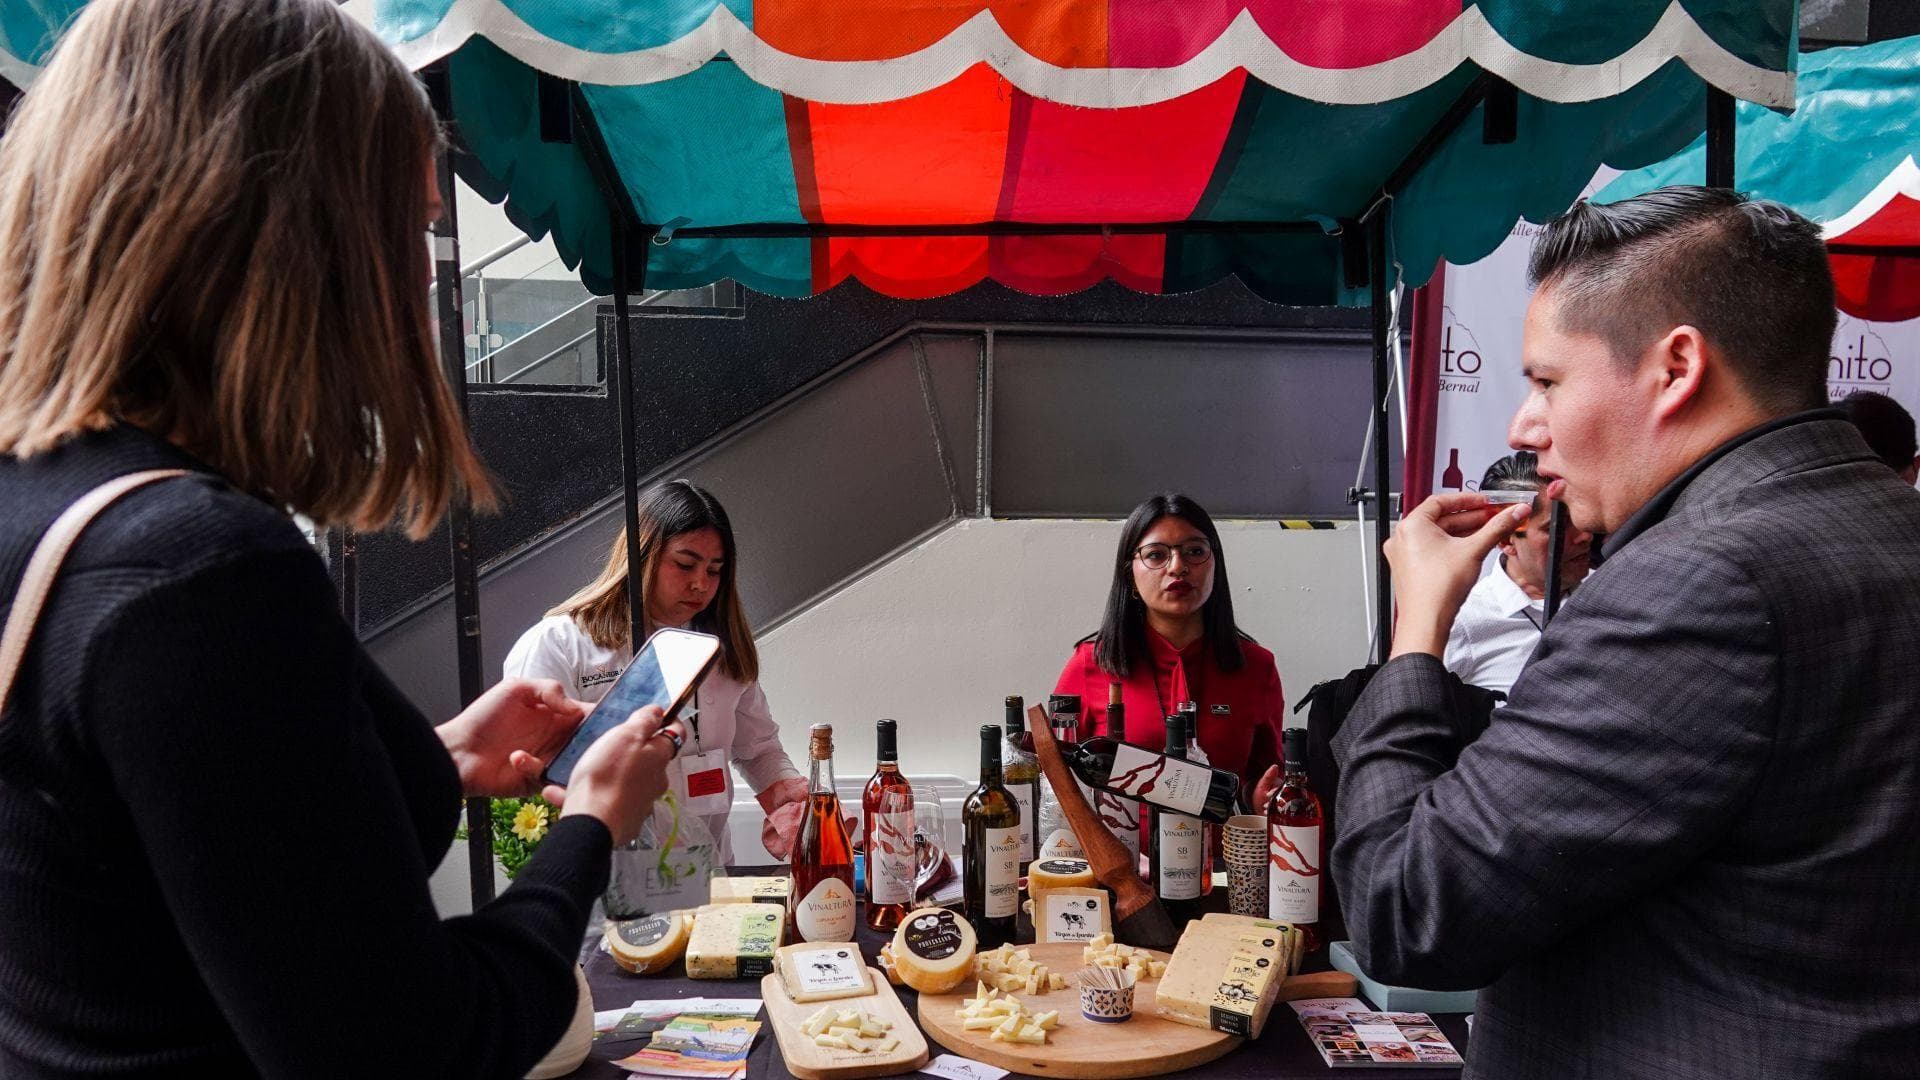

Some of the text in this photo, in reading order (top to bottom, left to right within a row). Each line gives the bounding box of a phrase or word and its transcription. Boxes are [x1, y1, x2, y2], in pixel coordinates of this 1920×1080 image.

[1439, 379, 1480, 393] Bernal
[1163, 828, 1200, 838] VINALTURA
[1177, 847, 1189, 855] SB
[1277, 885, 1311, 894] VINALTURA
[807, 898, 852, 912] VINALTURA
